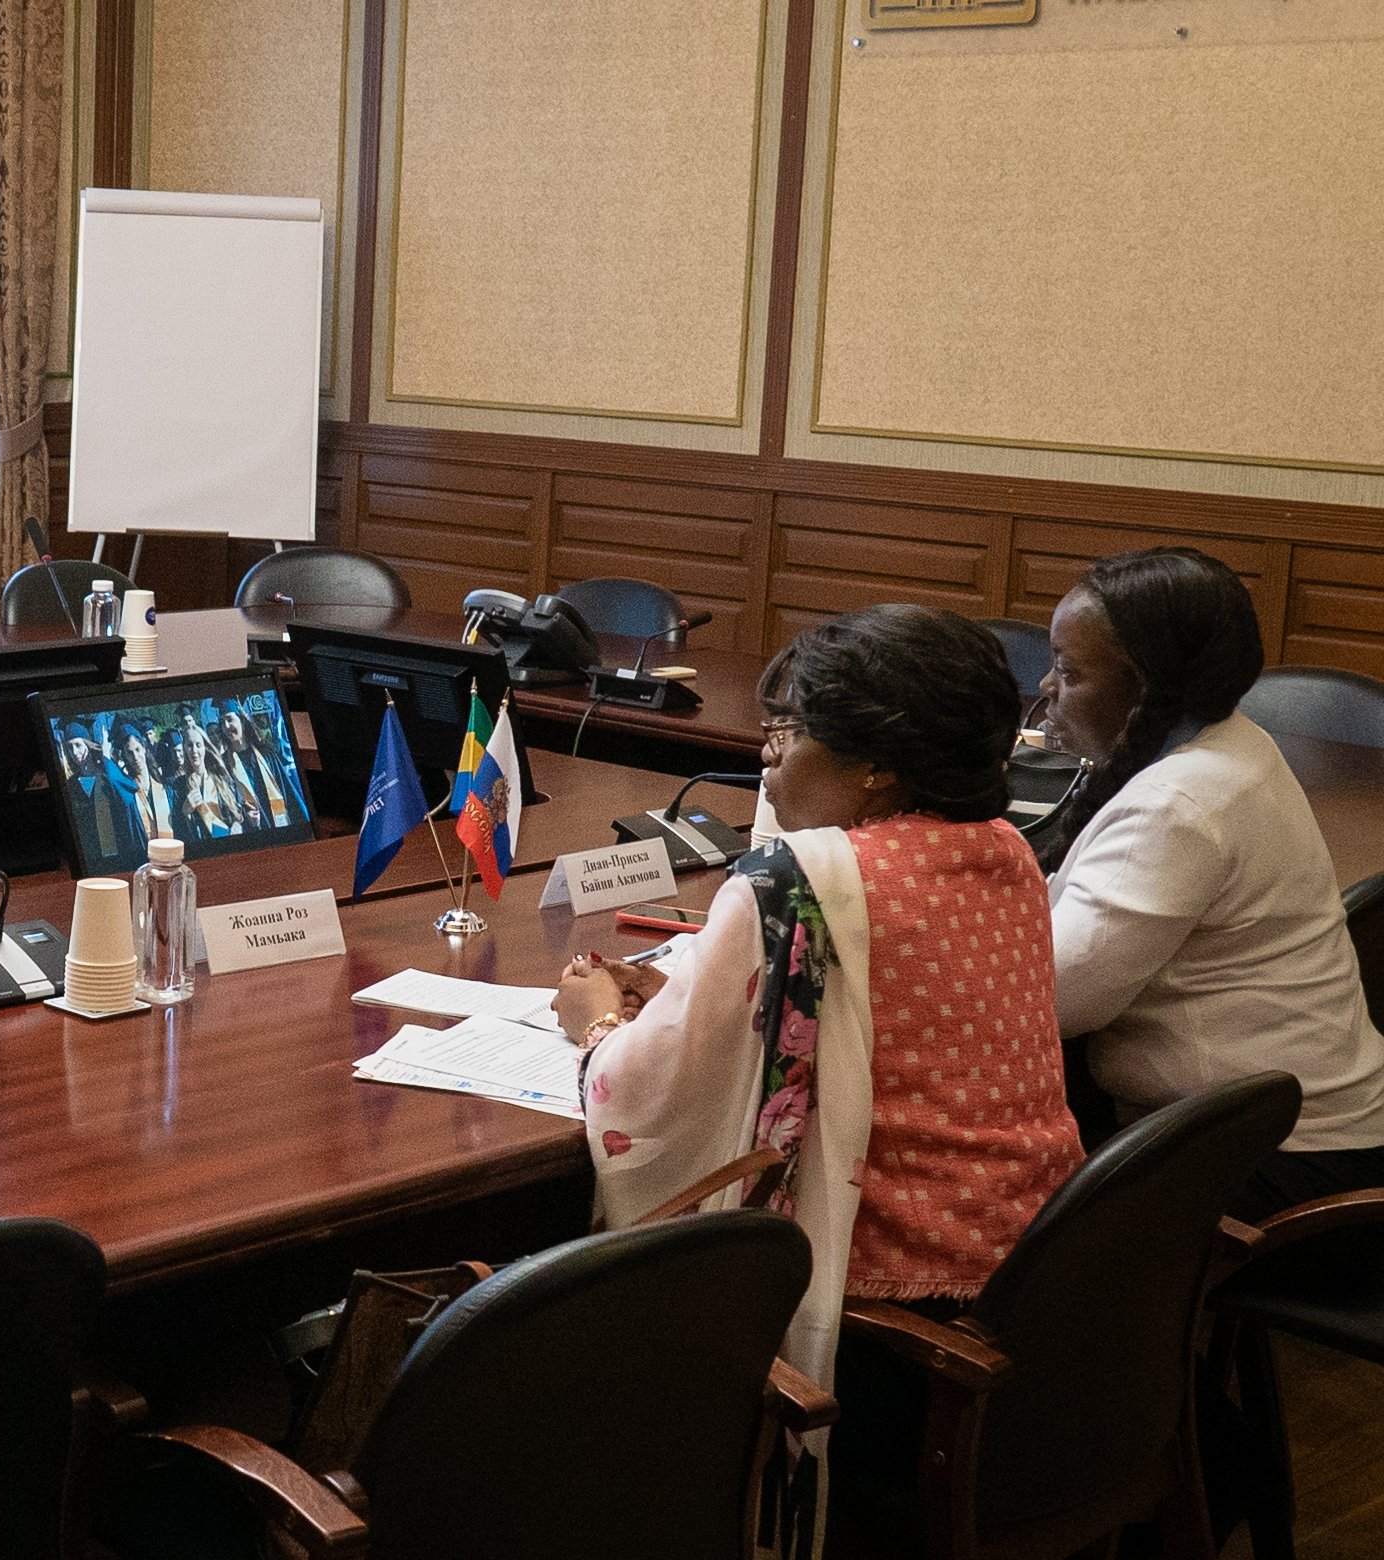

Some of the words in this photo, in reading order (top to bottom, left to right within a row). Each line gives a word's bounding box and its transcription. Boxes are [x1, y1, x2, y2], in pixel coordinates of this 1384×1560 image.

[583, 851, 650, 874] Диан-Приска
[580, 878, 614, 894] Байни
[616, 868, 661, 887] Акимова
[229, 912, 283, 930] Жоанна
[285, 907, 309, 920] Роз
[245, 930, 306, 949] Мамьака
